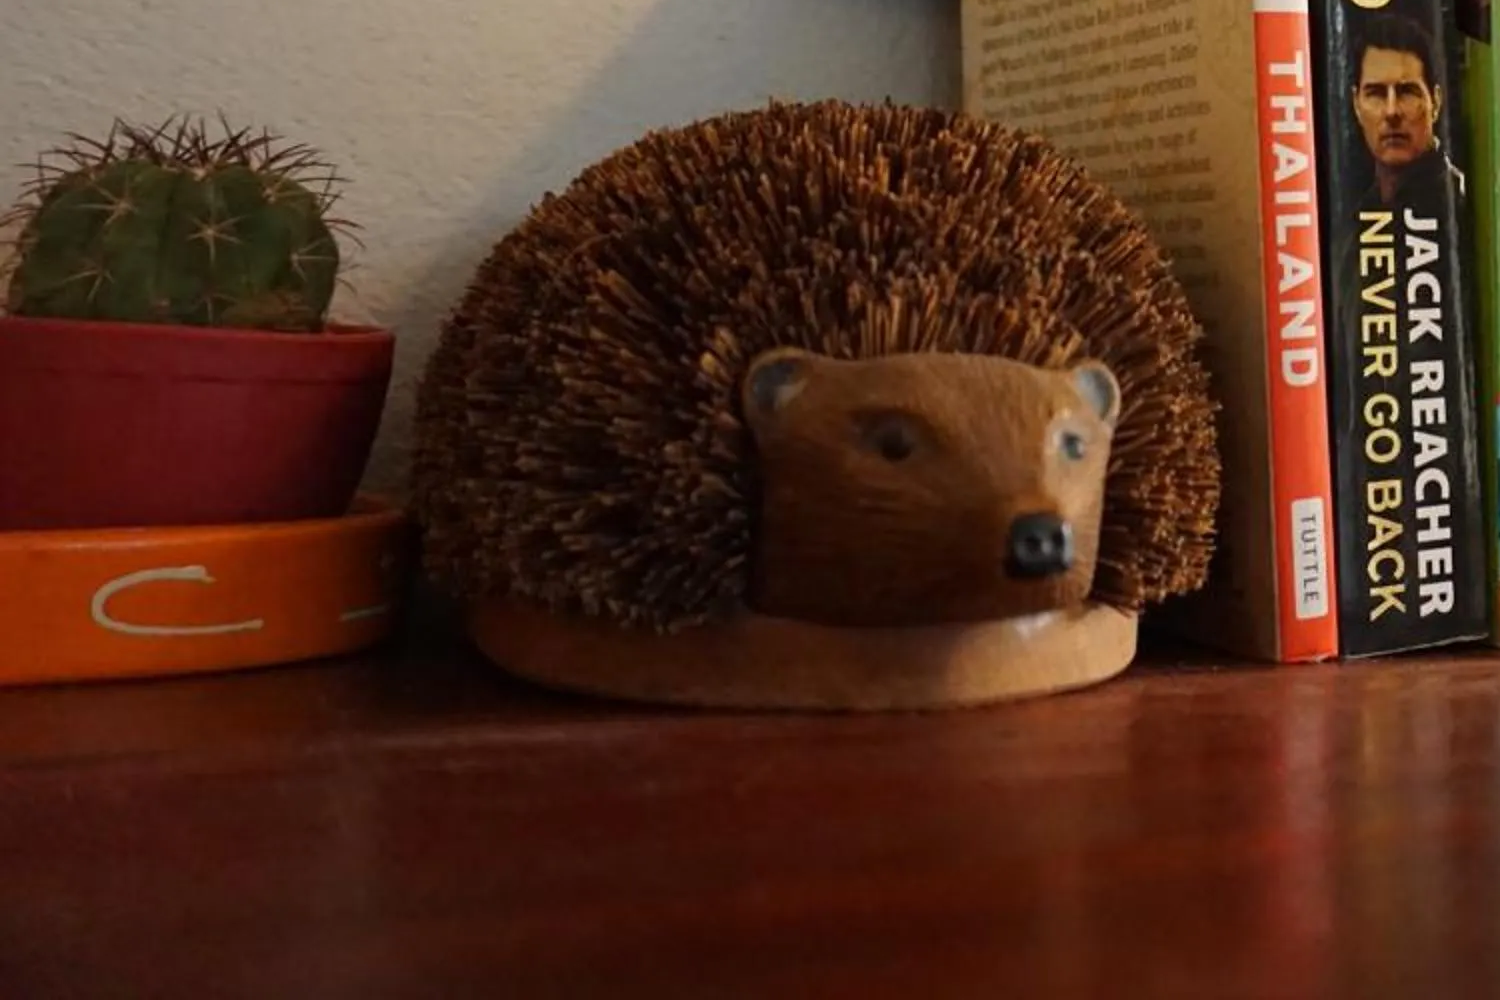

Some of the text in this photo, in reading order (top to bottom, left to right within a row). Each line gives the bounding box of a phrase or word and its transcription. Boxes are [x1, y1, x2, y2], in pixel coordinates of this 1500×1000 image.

[1269, 49, 1320, 388] THAILAND
[1299, 513, 1320, 604] TUTTLE
[1359, 211, 1406, 622] NEVER GO BACK
[1403, 208, 1455, 618] JACK REACHER
